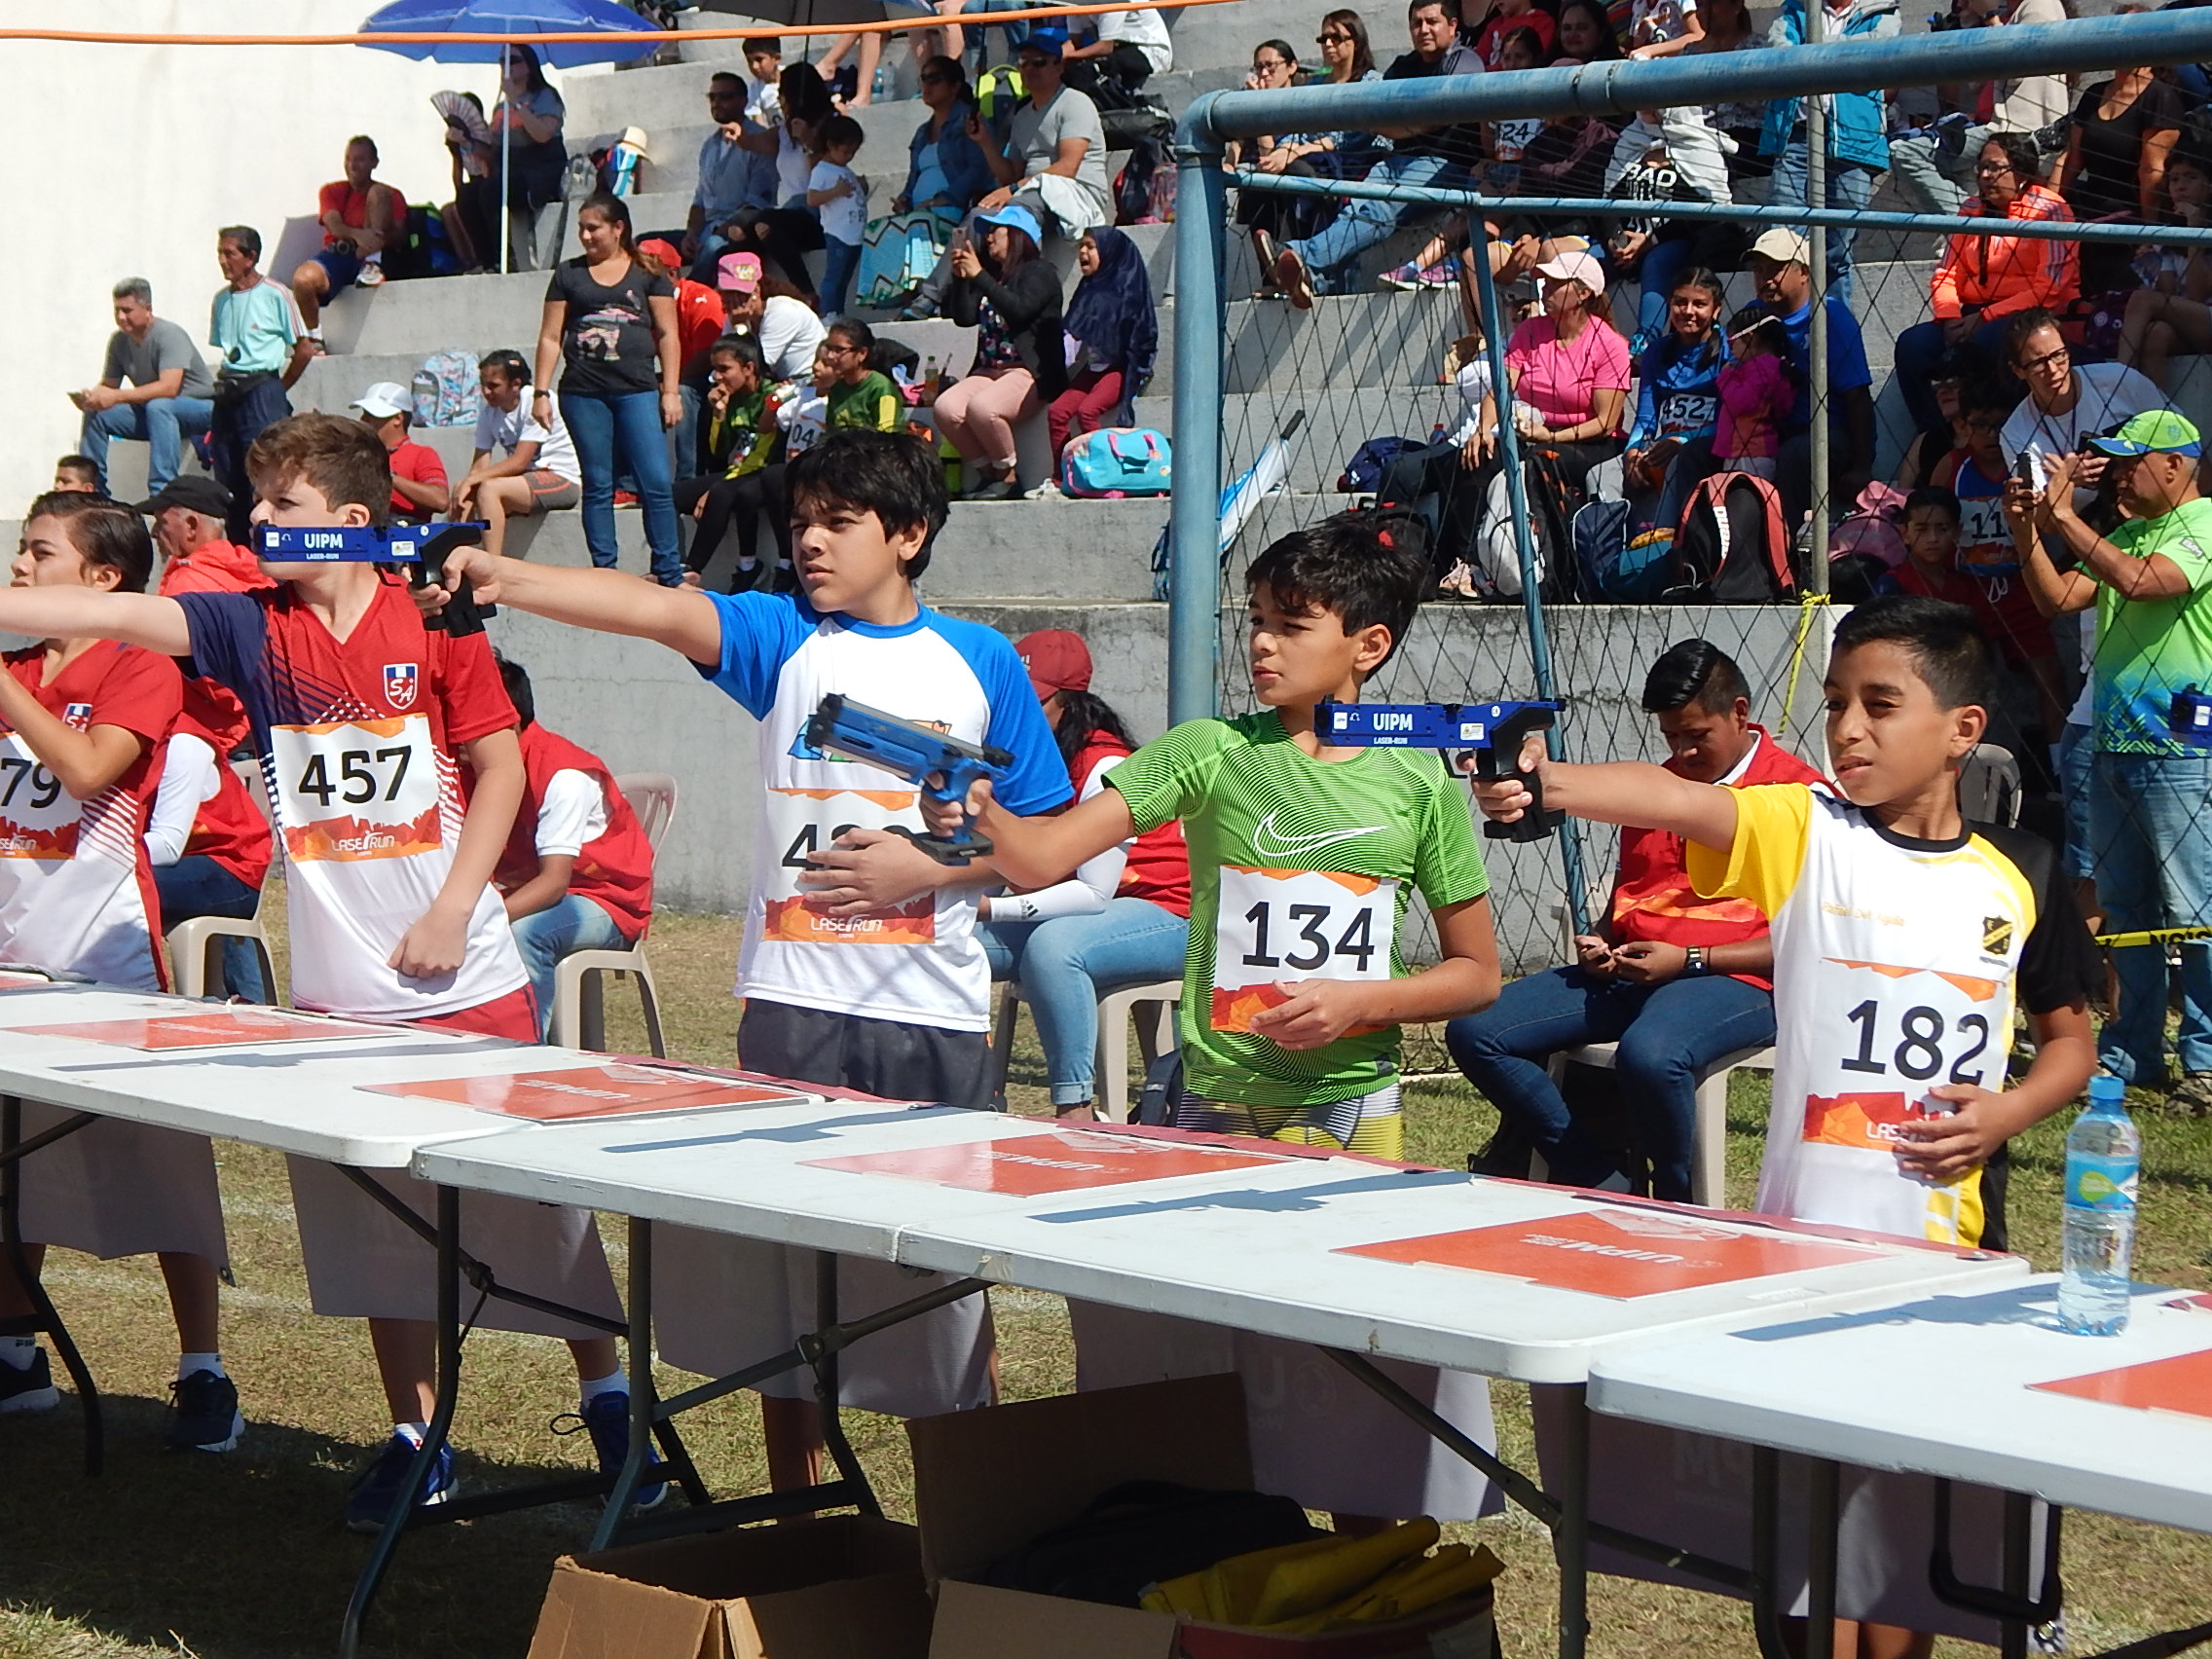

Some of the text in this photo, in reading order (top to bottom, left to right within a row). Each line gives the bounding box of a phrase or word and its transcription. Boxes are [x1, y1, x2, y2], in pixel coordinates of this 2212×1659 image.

[1662, 397, 1705, 419] 452
[1971, 511, 2008, 538] 11
[304, 533, 344, 549] UIPM
[1373, 713, 1413, 731] UIPM
[298, 745, 412, 806] 457
[1242, 901, 1376, 972] 134
[1841, 999, 1989, 1087] 182
[1559, 1239, 1685, 1265] UIPM
